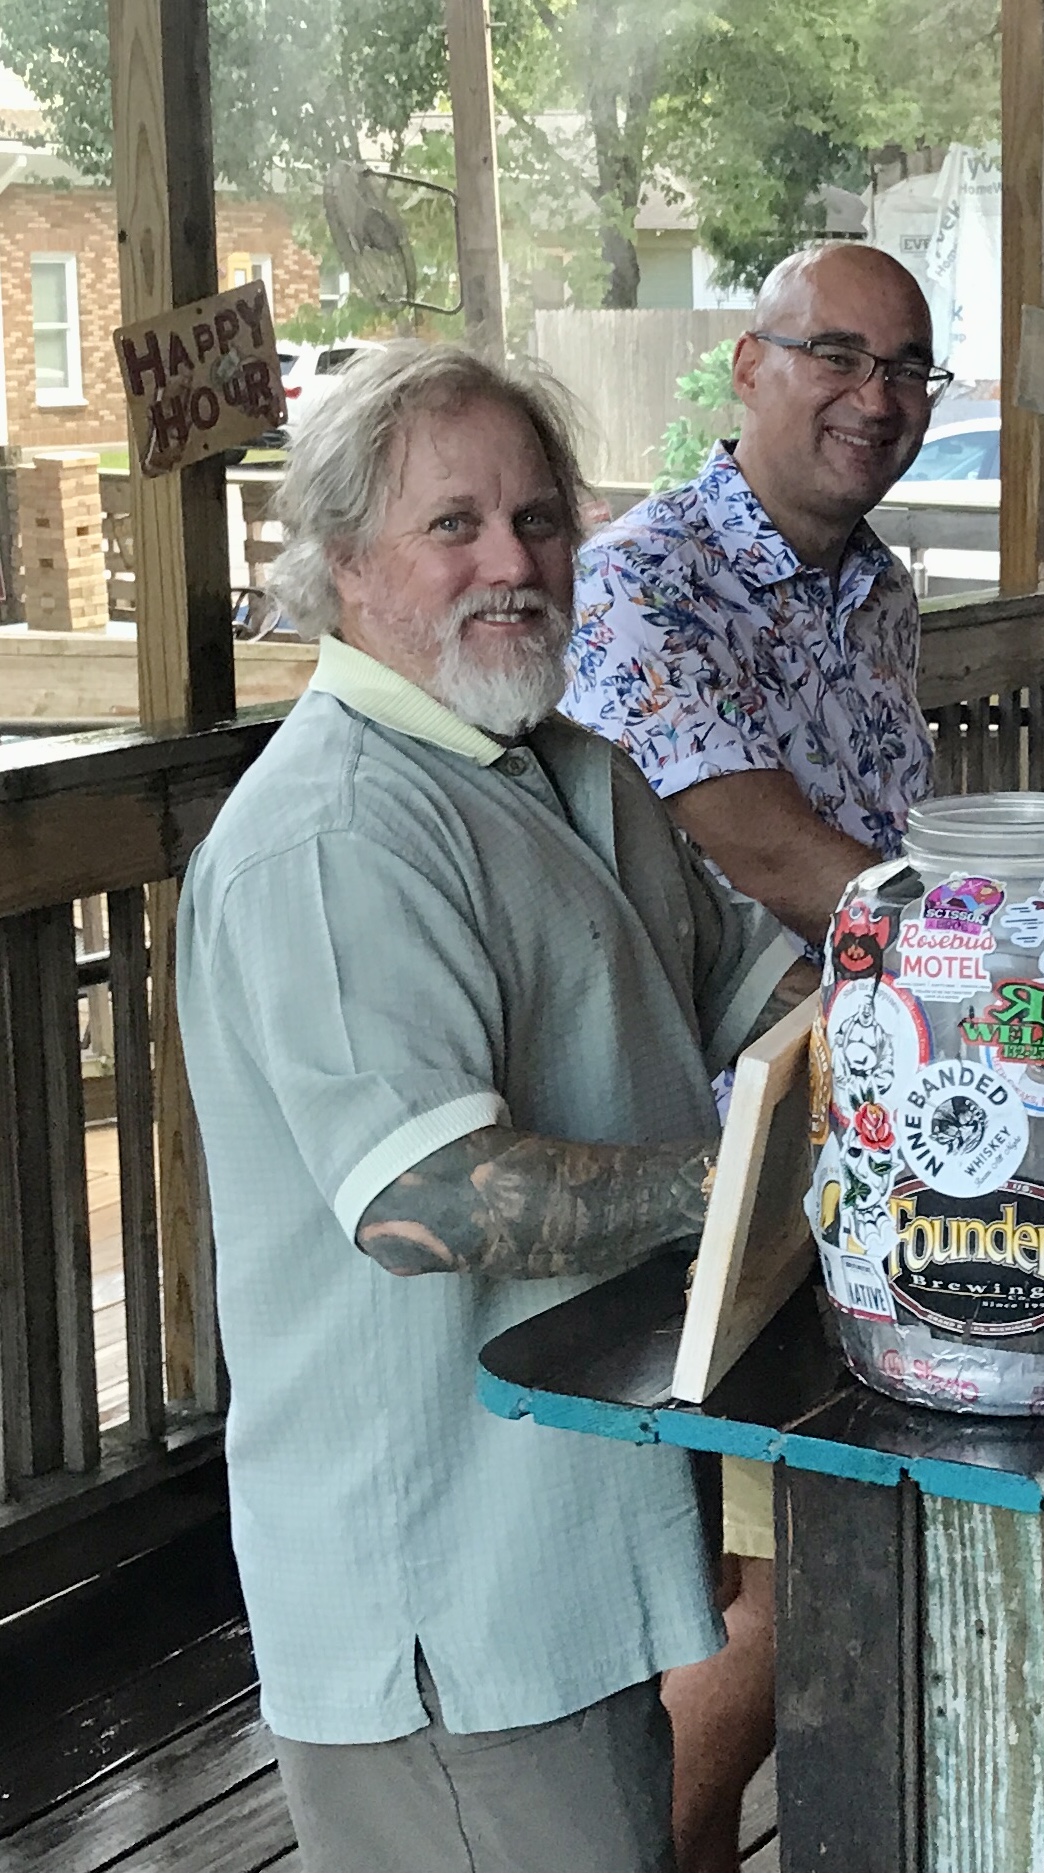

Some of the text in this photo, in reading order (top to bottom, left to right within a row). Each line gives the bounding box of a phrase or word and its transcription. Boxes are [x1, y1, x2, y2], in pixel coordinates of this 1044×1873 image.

[121, 291, 265, 397] HAPPY
[150, 360, 277, 453] HOUR
[899, 923, 995, 952] Rosebud
[903, 954, 988, 980] MOTEL
[907, 1066, 1009, 1110] BANDED
[904, 1113, 945, 1178] NINE
[963, 1125, 1012, 1178] WHISKEY
